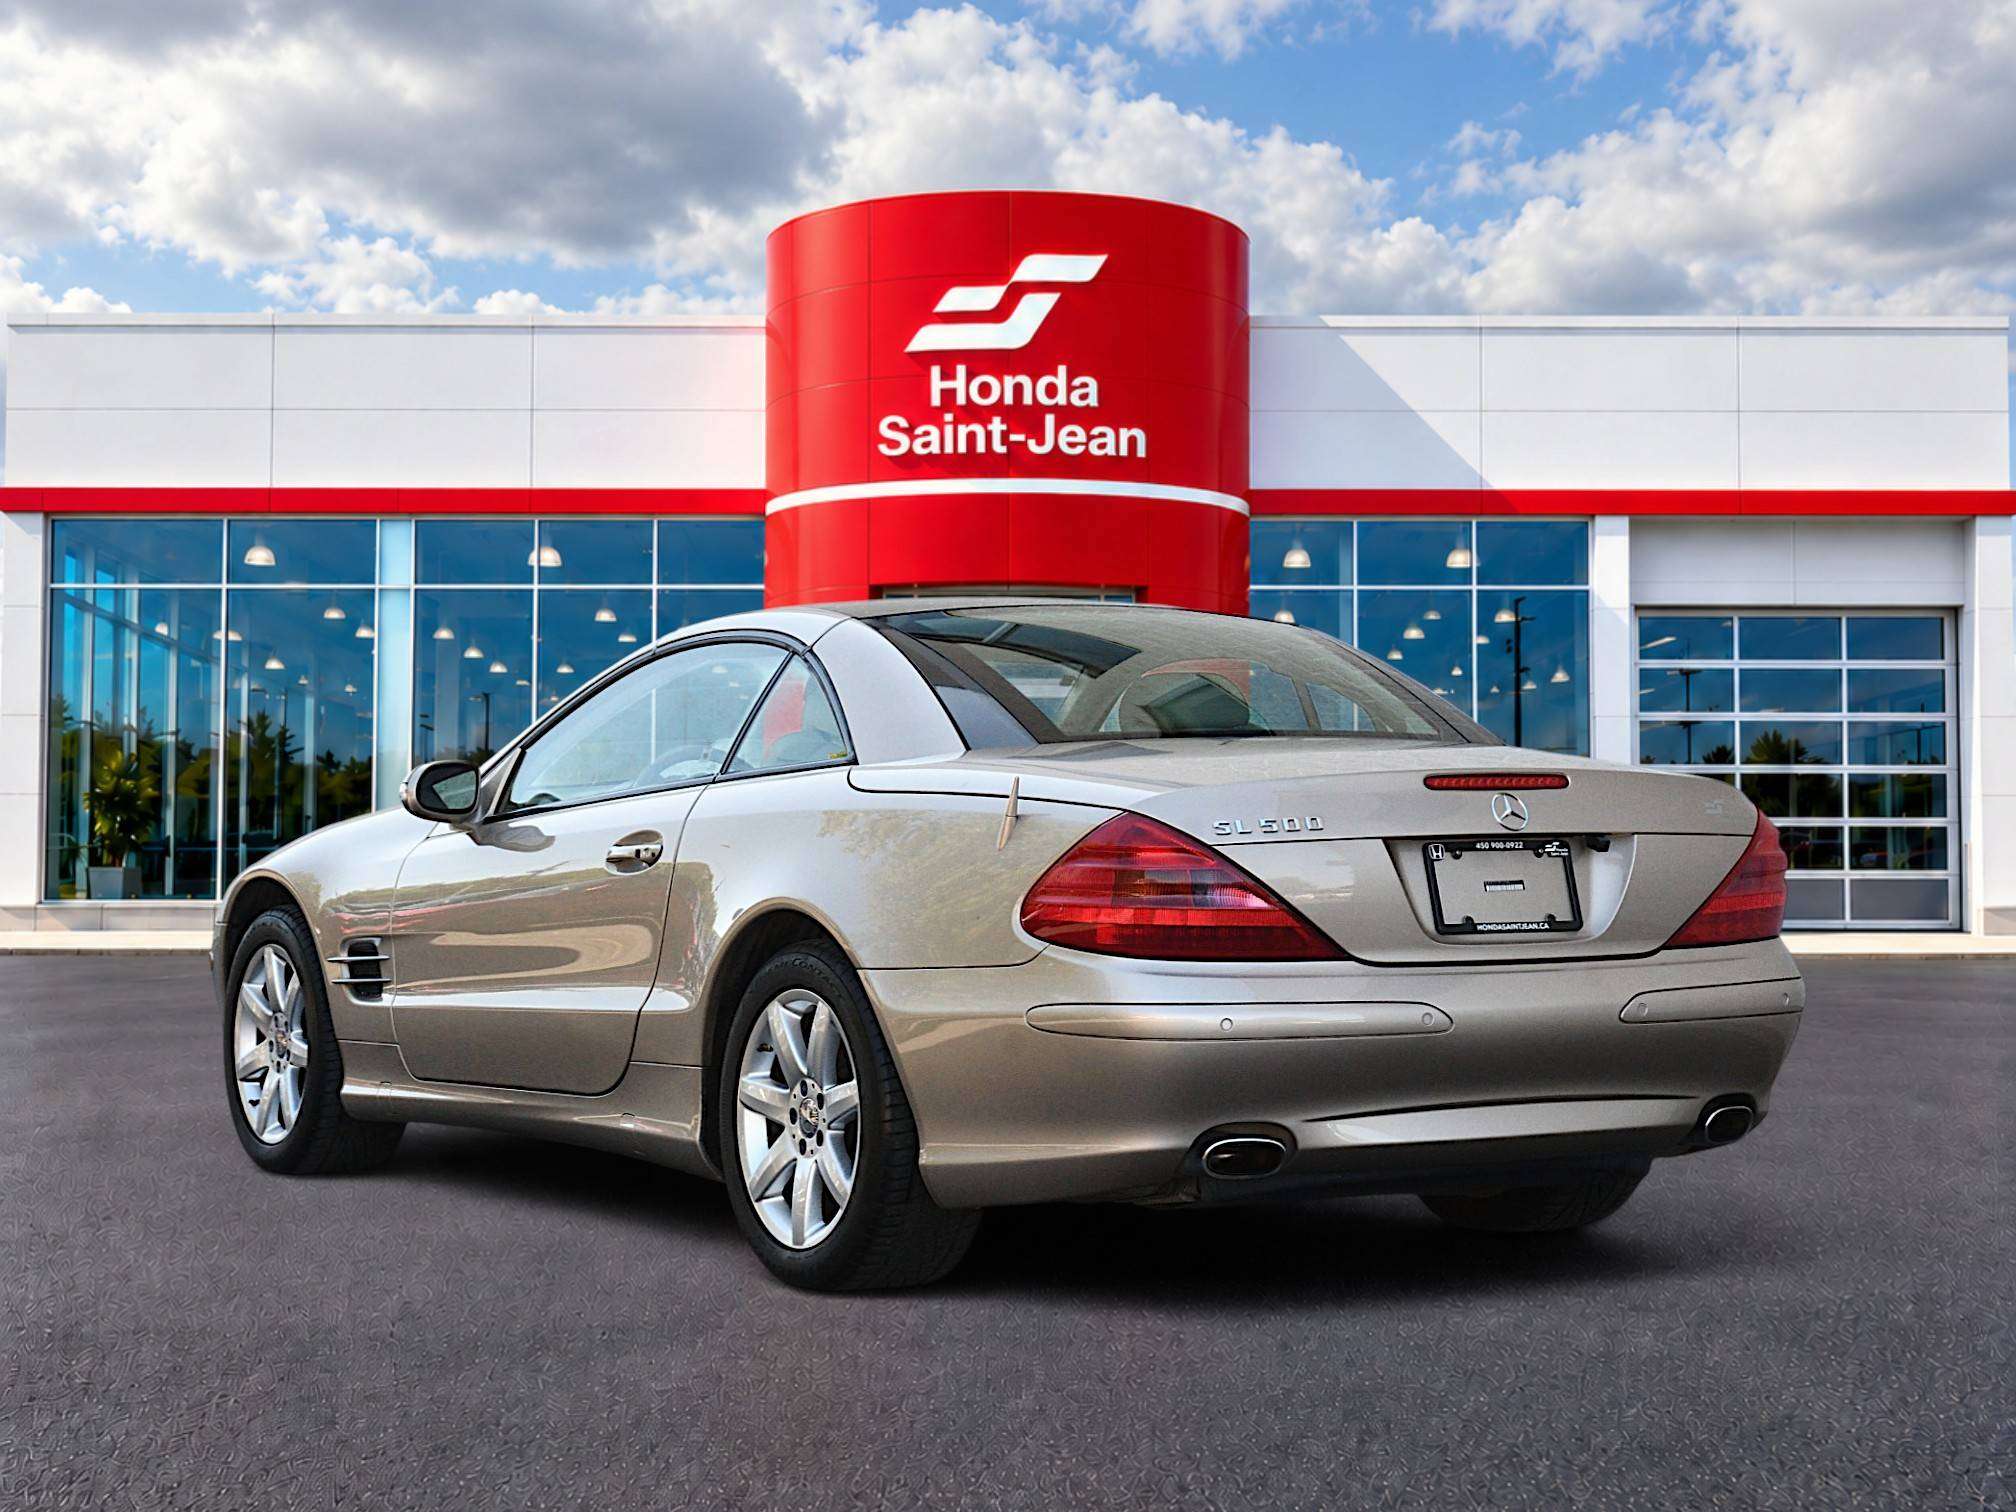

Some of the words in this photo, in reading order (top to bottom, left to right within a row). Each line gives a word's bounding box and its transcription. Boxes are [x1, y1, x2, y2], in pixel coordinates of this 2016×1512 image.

[929, 364, 1099, 407] Honda
[877, 412, 1147, 458] Saint-Jean
[1213, 819, 1253, 836] SL
[1259, 816, 1325, 834] 500
[1475, 842, 1489, 850] 450
[1476, 922, 1550, 932] HONDASAINTJEAN.CA
